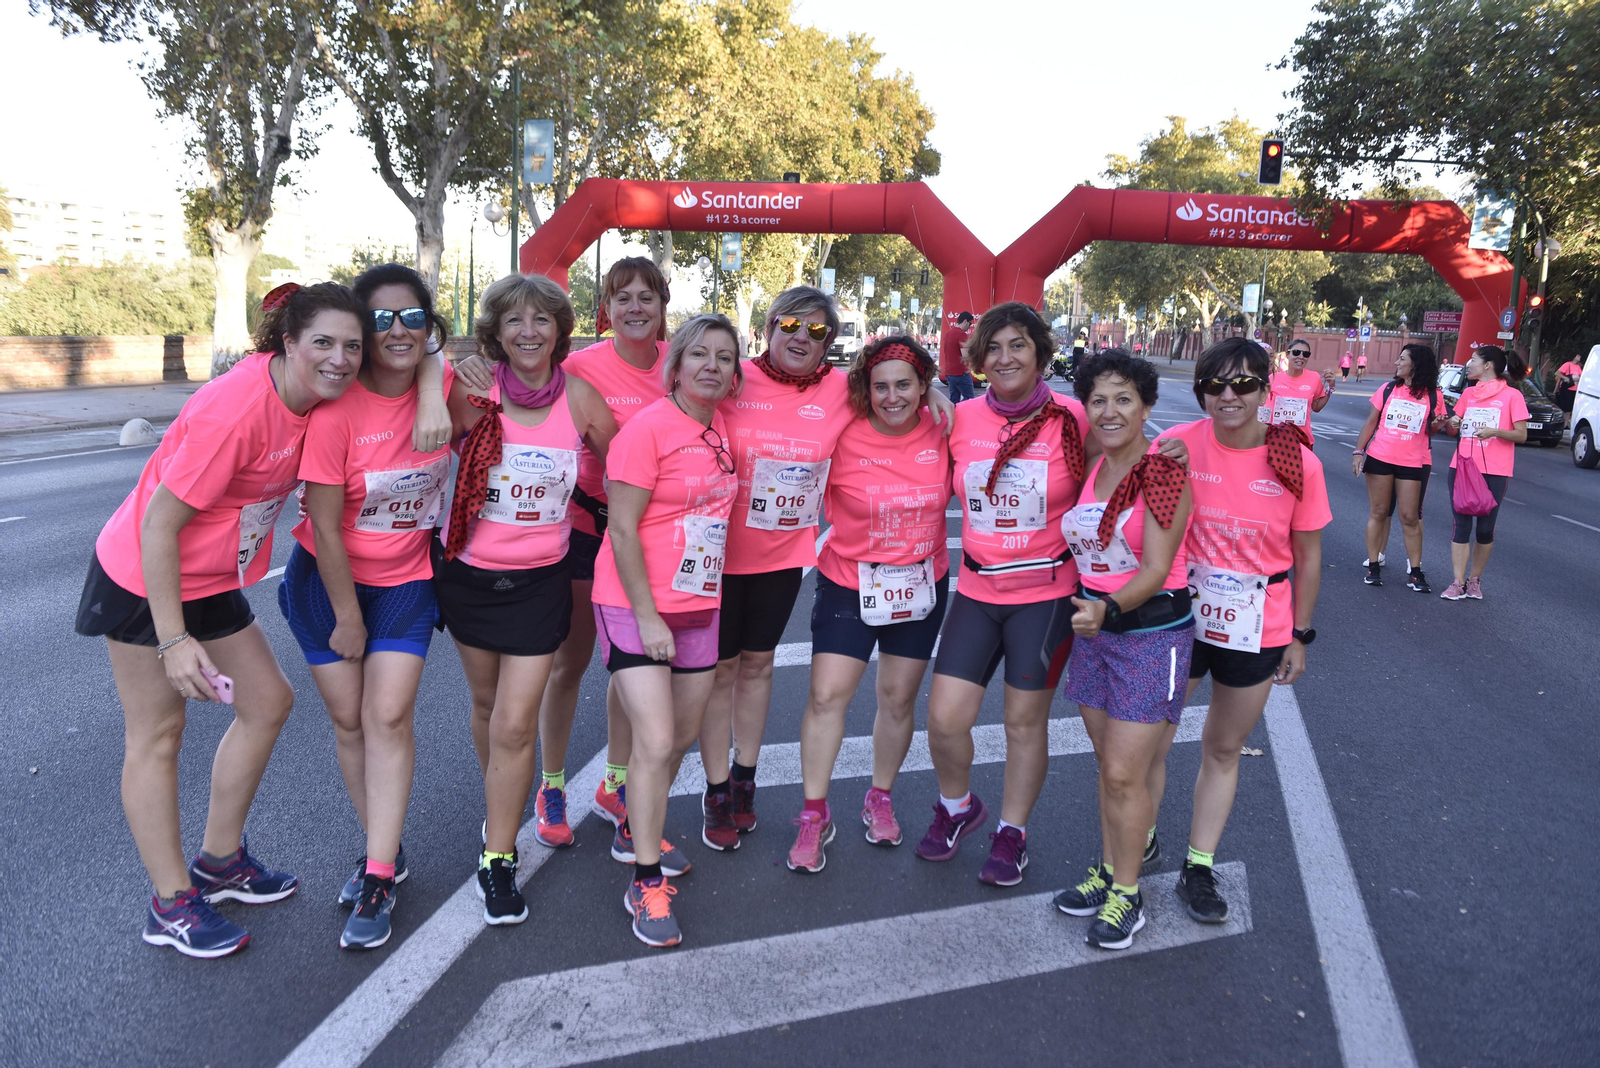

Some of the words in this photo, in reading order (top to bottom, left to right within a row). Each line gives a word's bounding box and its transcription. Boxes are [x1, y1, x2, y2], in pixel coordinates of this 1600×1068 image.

[701, 190, 803, 210] Santander
[1361, 327, 1370, 336] P
[606, 396, 643, 405] OYSHO
[736, 401, 773, 411] OYSHO
[1397, 413, 1412, 422] 016
[355, 430, 394, 446] OYSHO
[735, 427, 752, 438] HOY
[755, 430, 783, 441] GANAN
[679, 446, 709, 455] OYSHO
[763, 443, 785, 452] VITORIA
[970, 439, 1001, 450] OYSHO
[512, 458, 552, 470] ASTURIANA
[859, 458, 892, 467] OYSHO
[1187, 470, 1223, 484] OYSHO
[395, 477, 430, 492] ASTURIANA
[866, 485, 880, 495] HOY
[1252, 483, 1281, 494] ASTURIANA
[511, 484, 546, 500] 016
[388, 497, 424, 513] 016
[517, 501, 537, 510] 8976
[776, 495, 805, 508] 016
[892, 496, 913, 504] VITORIA
[989, 494, 1020, 507] 016
[780, 509, 798, 517] 8922
[906, 526, 937, 540] CHICAS
[913, 540, 935, 556] 2019
[1002, 535, 1030, 550] 2019
[1080, 538, 1105, 552] 016
[703, 555, 722, 571] 016
[882, 567, 914, 575] ASTURIANA
[1204, 579, 1240, 592] ASTURIANA
[884, 587, 914, 602] 016
[892, 603, 908, 611] 8977
[1200, 603, 1237, 622] 016
[1206, 620, 1226, 631] 8924
